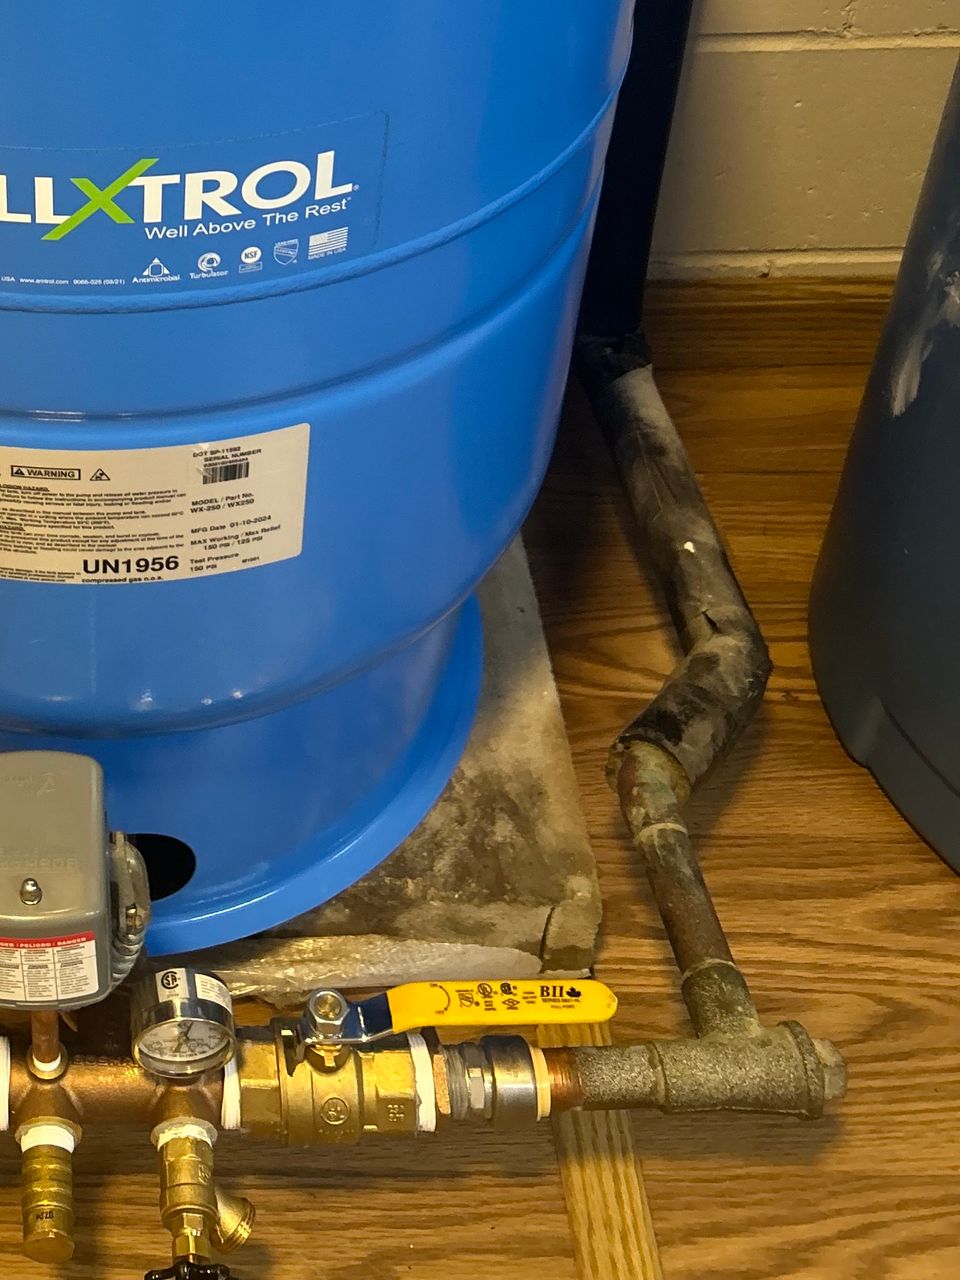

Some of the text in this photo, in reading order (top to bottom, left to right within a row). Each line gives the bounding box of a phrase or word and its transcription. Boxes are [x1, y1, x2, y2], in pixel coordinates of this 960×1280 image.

[144, 198, 347, 240] Well Above The Rest
[244, 250, 258, 260] NSF
[132, 274, 181, 284] Antimicrobial
[189, 269, 228, 280] Turbulator
[231, 449, 262, 458] NUMBER
[27, 469, 76, 478] WARNING
[192, 498, 219, 506] MODEL
[225, 494, 240, 502] Part
[190, 499, 254, 513] WX-250 WX250
[209, 534, 239, 543] Working
[207, 553, 239, 562] Pressure
[83, 556, 179, 574] UN1956
[540, 986, 564, 998] BII
